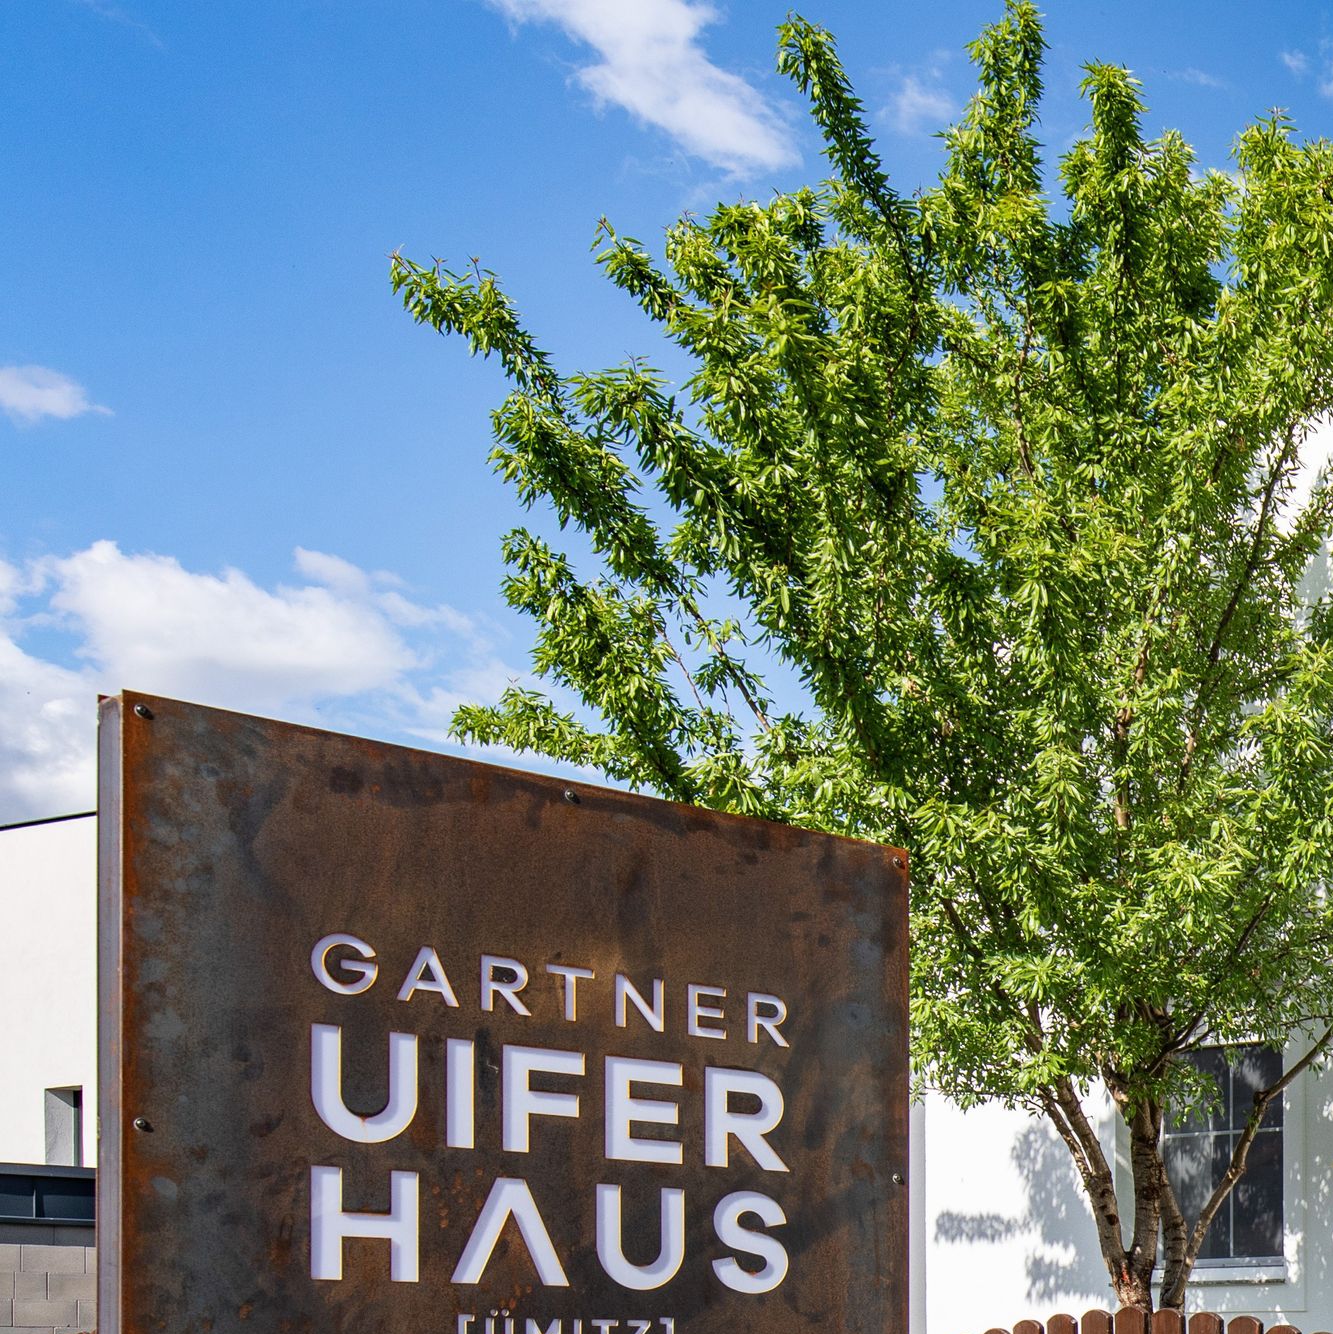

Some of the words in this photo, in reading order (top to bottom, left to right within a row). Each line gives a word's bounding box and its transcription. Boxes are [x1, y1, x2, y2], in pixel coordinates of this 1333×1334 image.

[311, 932, 790, 1047] GARTNER
[310, 1022, 790, 1173] UIFER
[310, 1164, 790, 1295] HAUS
